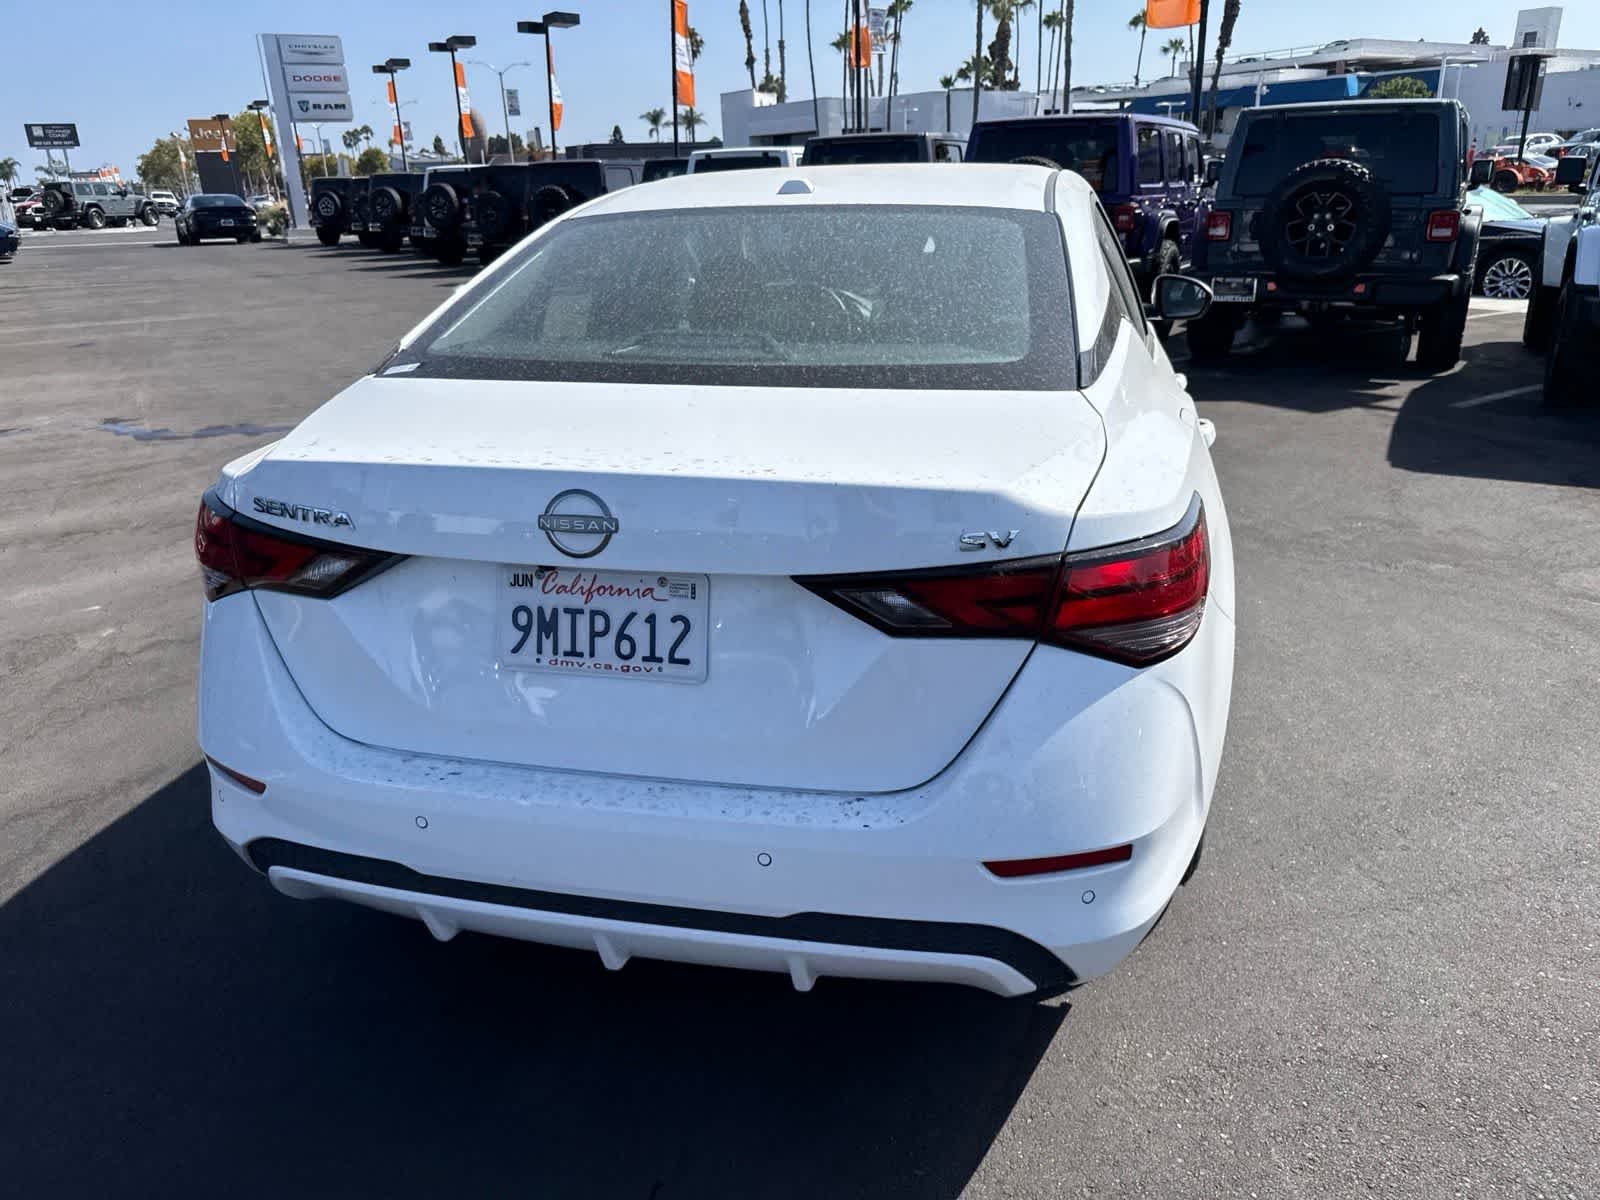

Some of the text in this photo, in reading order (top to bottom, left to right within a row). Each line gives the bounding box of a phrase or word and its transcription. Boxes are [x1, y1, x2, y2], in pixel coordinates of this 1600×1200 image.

[292, 74, 342, 82] DODGE
[253, 496, 357, 531] SENTRA
[540, 518, 616, 531] NISSAN
[960, 529, 1021, 552] SV
[510, 573, 534, 588] JUN
[542, 570, 669, 605] California
[510, 605, 691, 665] 9MIP612
[548, 657, 653, 674] dmv.ca.gov
